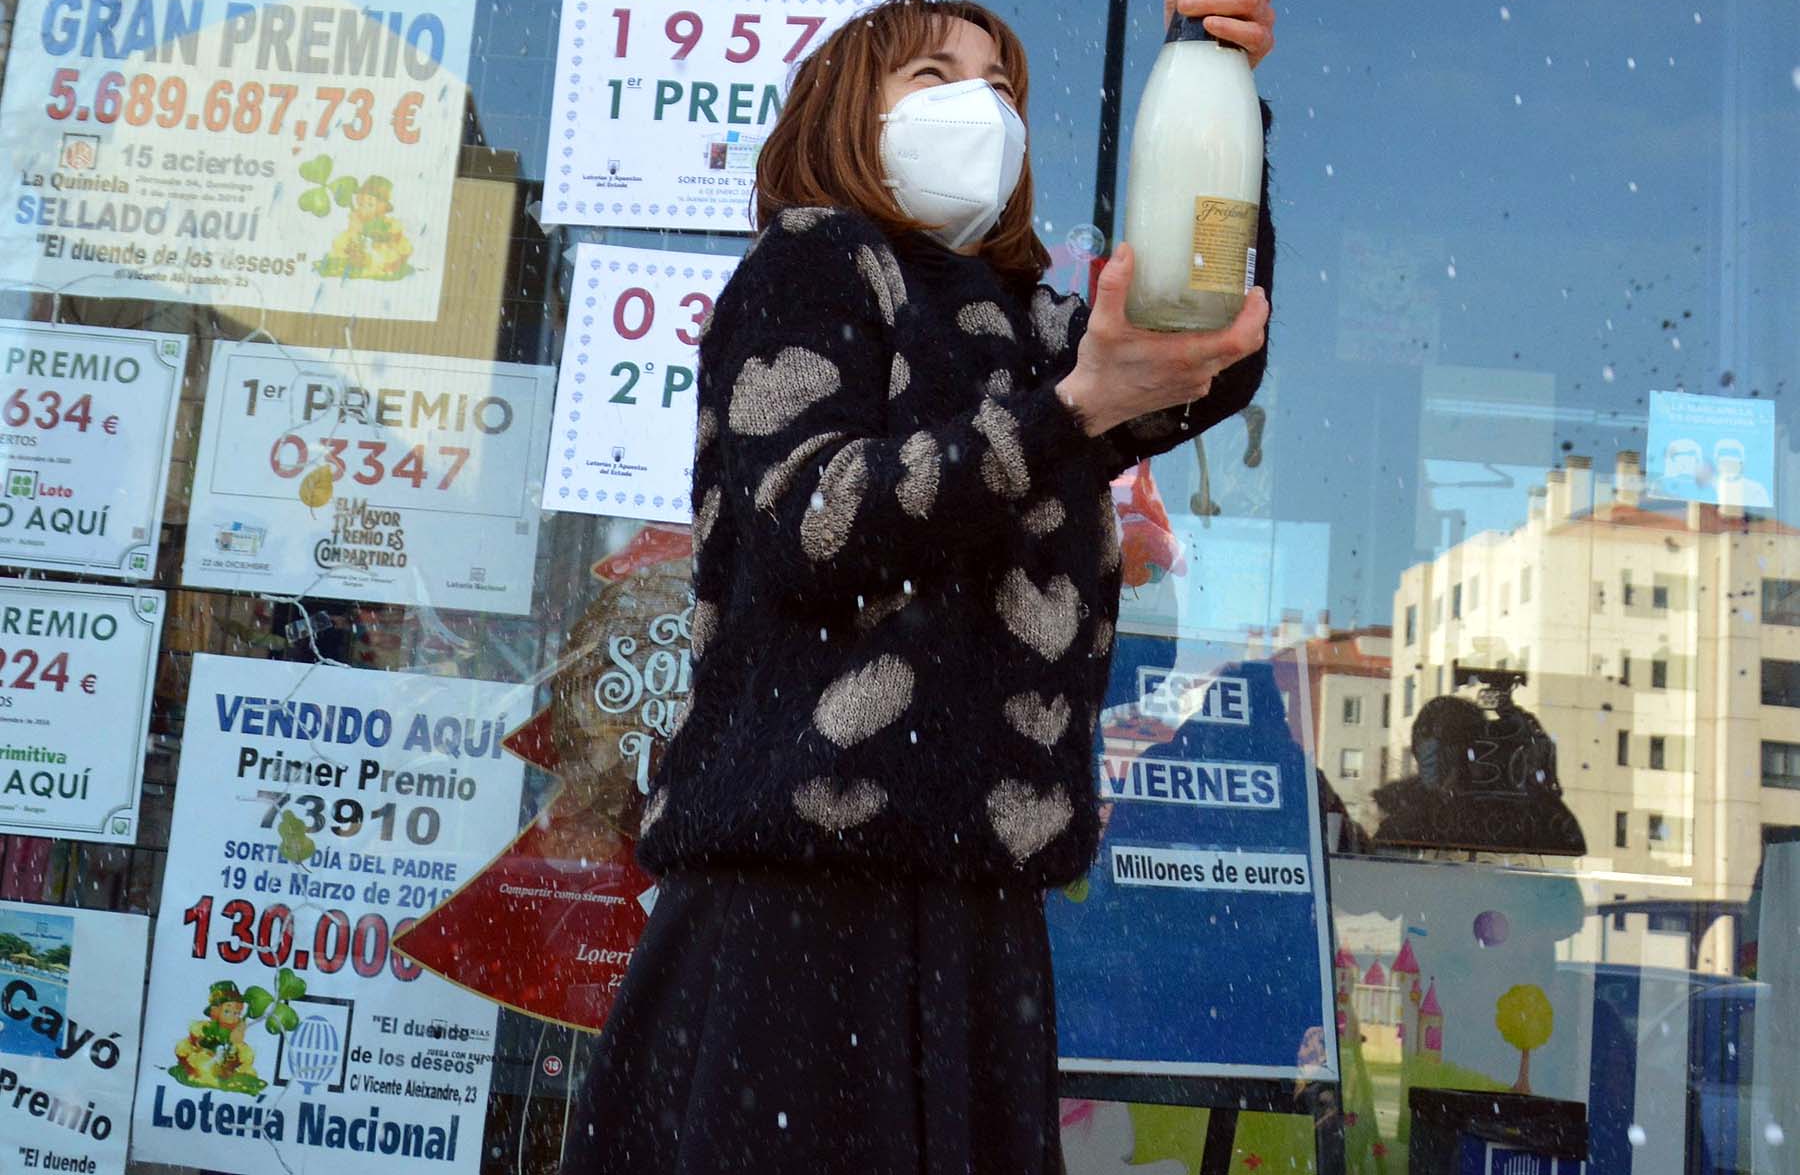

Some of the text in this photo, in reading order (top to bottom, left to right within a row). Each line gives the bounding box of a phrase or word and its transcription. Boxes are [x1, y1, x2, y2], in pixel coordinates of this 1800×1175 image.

[219, 2, 446, 81] PREMIO
[46, 68, 425, 144] 5.689.687,73 €
[121, 144, 276, 179] 15 aciertos
[21, 172, 129, 195] La Quiniela
[678, 176, 715, 185] SORTEO
[718, 177, 729, 185] DE
[15, 195, 261, 241] SELLADO AQUÍ
[36, 233, 64, 258] "El
[70, 239, 146, 265] duende
[153, 244, 177, 264] de
[6, 347, 140, 384] PREMIO
[243, 379, 513, 435] 1er PREMIO
[102, 415, 119, 435] €
[270, 435, 471, 490] 03347
[39, 483, 73, 498] Loto
[25, 505, 110, 537] AQUÍ
[350, 498, 401, 529] MAYOR
[225, 561, 273, 571] DICIEMBRE
[314, 538, 407, 570] COMPARTIRLO
[80, 674, 97, 694] €
[216, 693, 506, 760] VENDIDO AQUÍ
[4, 768, 93, 800] AQUÍ
[237, 747, 476, 801] Primer Premio
[1103, 759, 1275, 805] VIERNES
[257, 790, 441, 845] 73910
[310, 846, 342, 870] DÍA
[350, 853, 386, 875] DEL
[392, 858, 457, 882] PADRE
[1116, 854, 1305, 885] Millones de euros
[221, 866, 247, 890] 19
[254, 870, 281, 893] de
[289, 873, 355, 901] Marzo
[364, 881, 390, 905] de
[500, 884, 626, 905] Compartir como siempre.
[1, 979, 122, 1069] Cayó
[373, 1014, 470, 1041] "El duende
[351, 1046, 372, 1063] de
[379, 1048, 405, 1066] los
[364, 1075, 402, 1096] Vicente
[405, 1080, 462, 1103] Aleixandre,
[465, 1085, 477, 1103] 23
[153, 1084, 460, 1161] Lotería Nacional
[19, 1146, 96, 1174] "El duende
